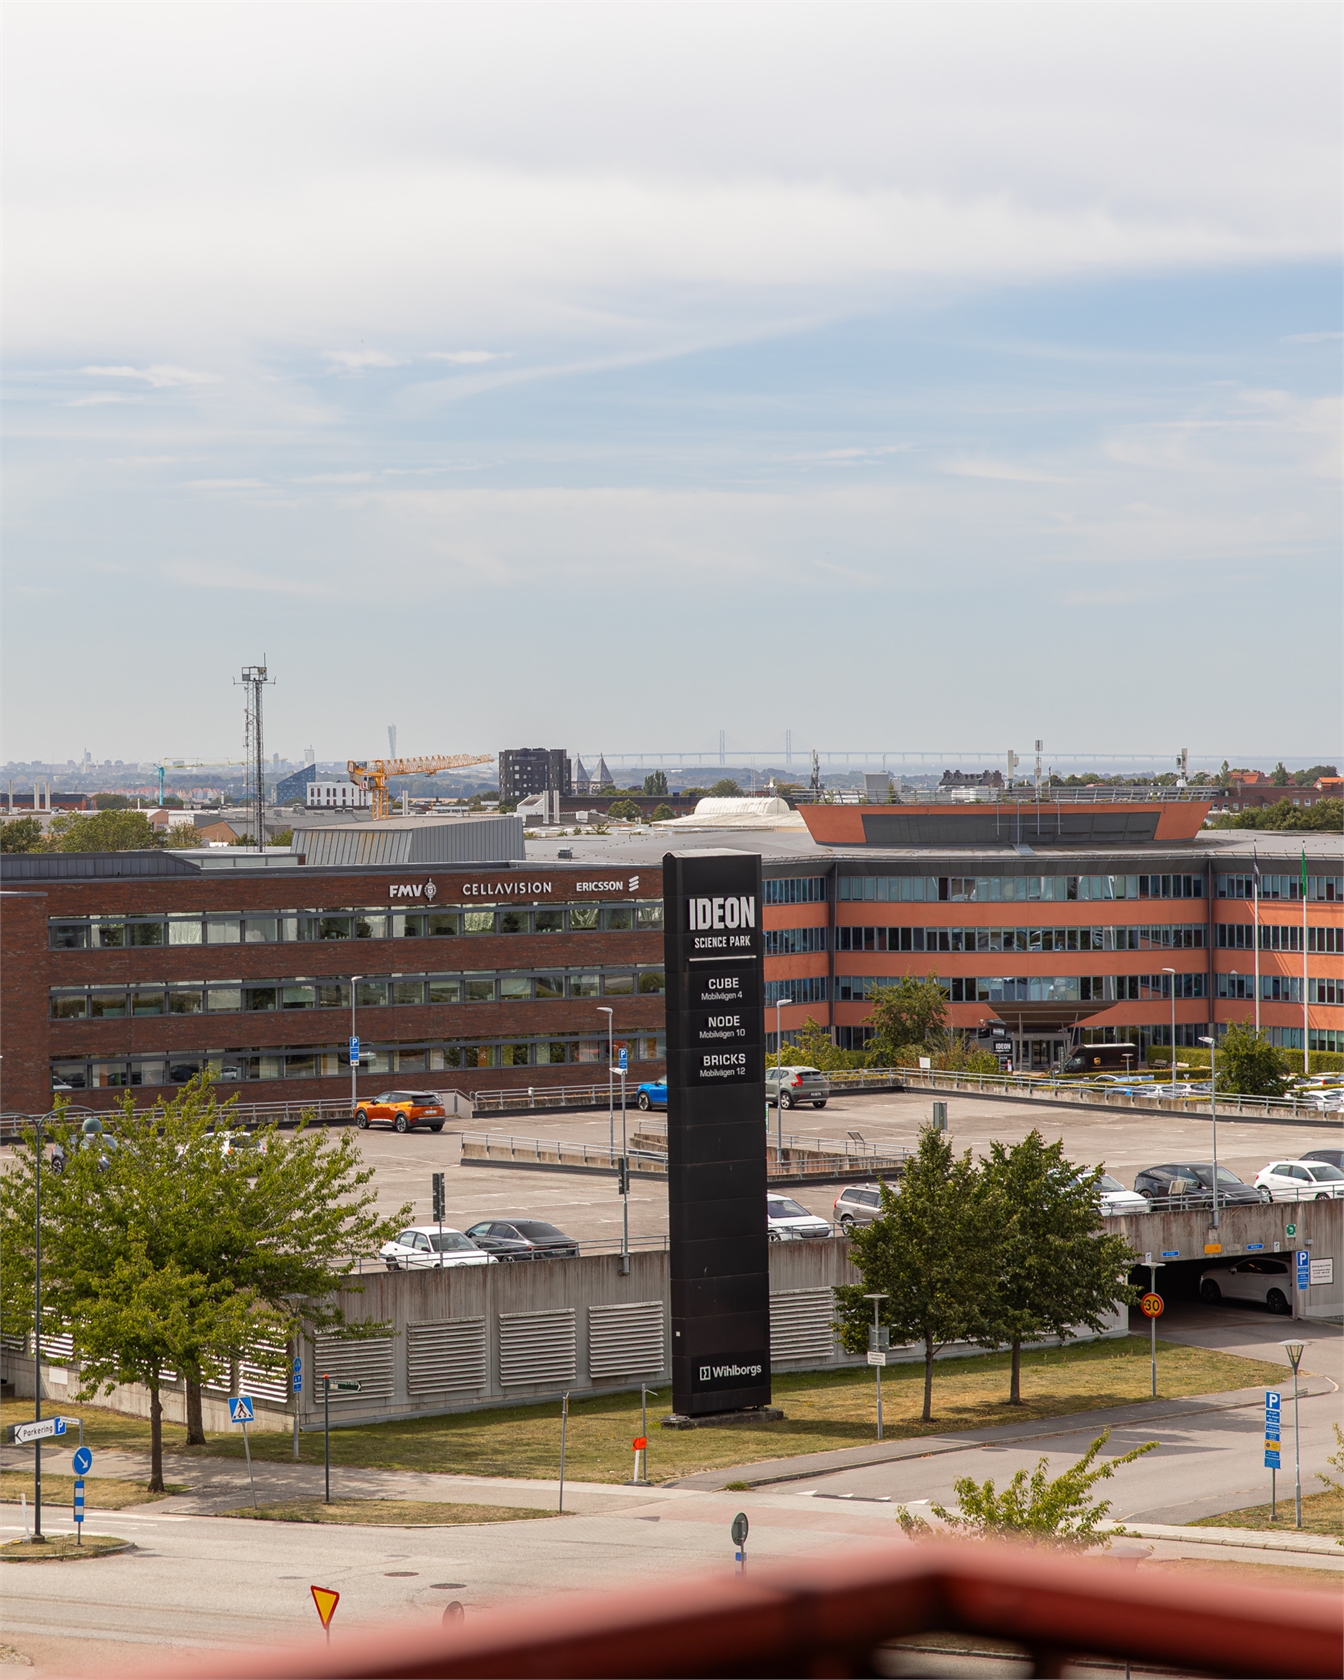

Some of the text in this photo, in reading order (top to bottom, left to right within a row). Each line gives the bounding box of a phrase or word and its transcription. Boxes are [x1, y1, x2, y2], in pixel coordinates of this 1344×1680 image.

[389, 884, 423, 898] FMV
[462, 882, 552, 895] CELLAVISION
[576, 881, 624, 892] ERICSSON
[689, 896, 755, 930] IDEON
[694, 935, 751, 949] SCIENCE PARK
[708, 977, 740, 990] CUBE
[701, 991, 743, 1001] Mobilvägen 4
[708, 1015, 741, 1028] NODE
[699, 1028, 746, 1040] Mobilvägen 10
[703, 1053, 746, 1067] BRICKS
[699, 1067, 746, 1078] Mobilvägen 12
[1299, 1252, 1307, 1266] P
[1145, 1299, 1160, 1312] 30
[712, 1364, 762, 1378] Wihlborgs
[1269, 1393, 1279, 1408] P
[23, 1425, 53, 1437] Parkering
